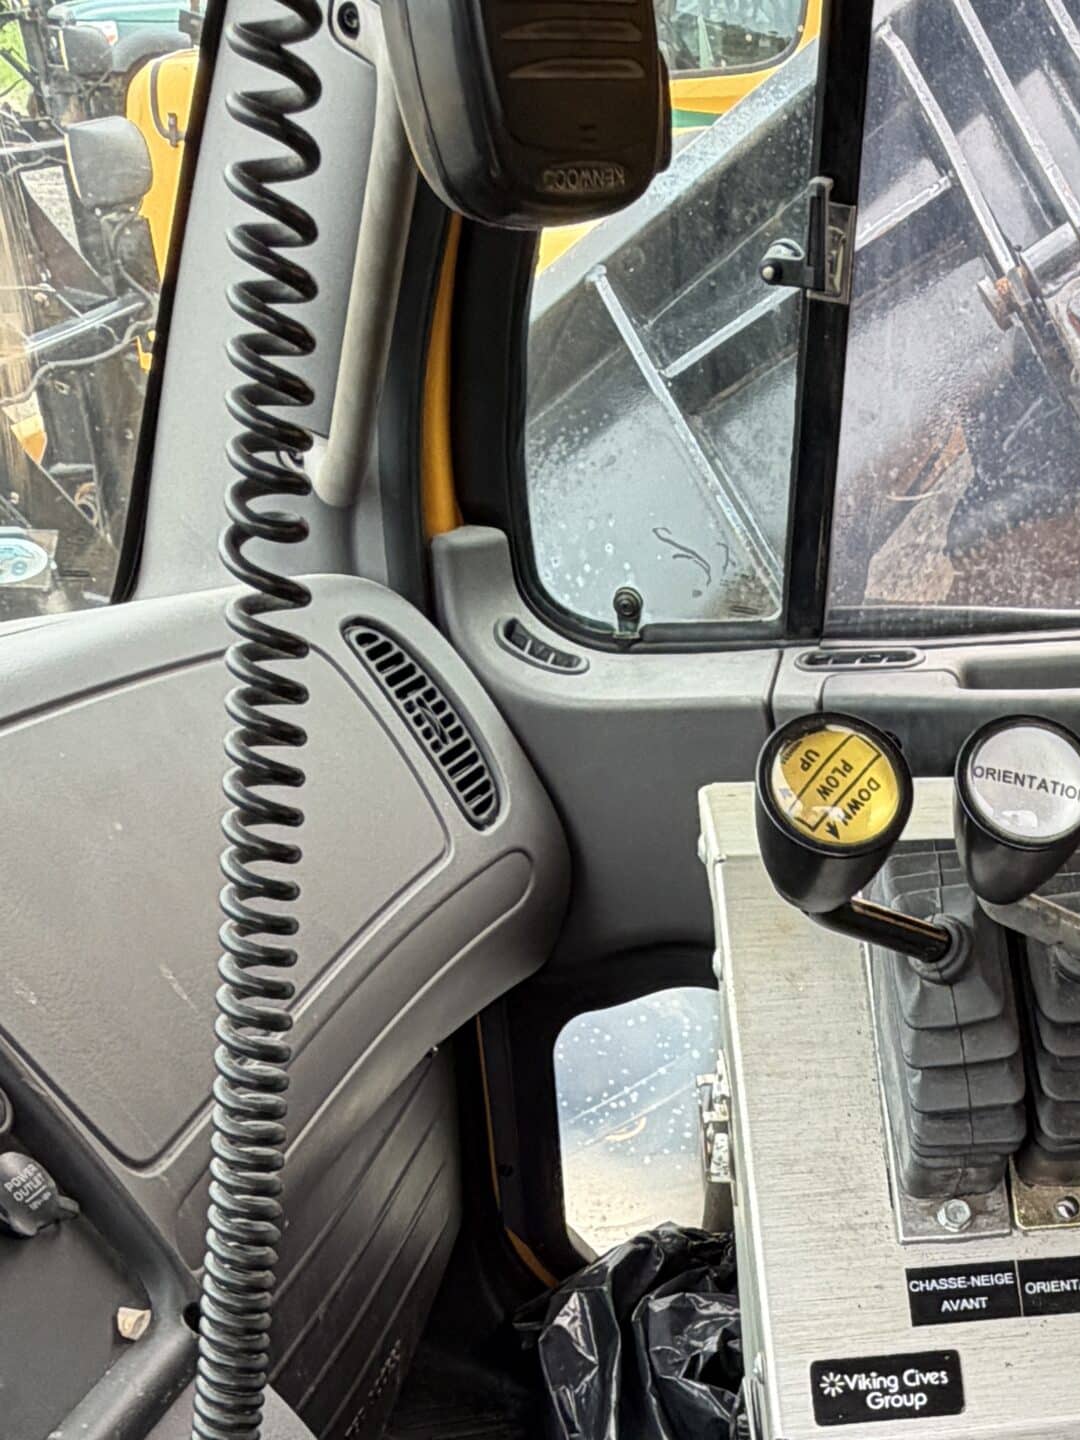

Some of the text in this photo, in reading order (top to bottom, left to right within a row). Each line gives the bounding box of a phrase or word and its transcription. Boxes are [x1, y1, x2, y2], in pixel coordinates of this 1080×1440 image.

[800, 749, 820, 773] UP
[815, 758, 854, 801] PLOW
[839, 776, 882, 826] DOWN
[4, 1163, 38, 1192] POWER
[13, 1172, 46, 1202] OUTLET
[909, 1272, 1015, 1293] CHASSE-NEIGE
[940, 1296, 989, 1313] AVANT
[844, 1368, 949, 1394] Viking Cives
[866, 1391, 928, 1411] Group
